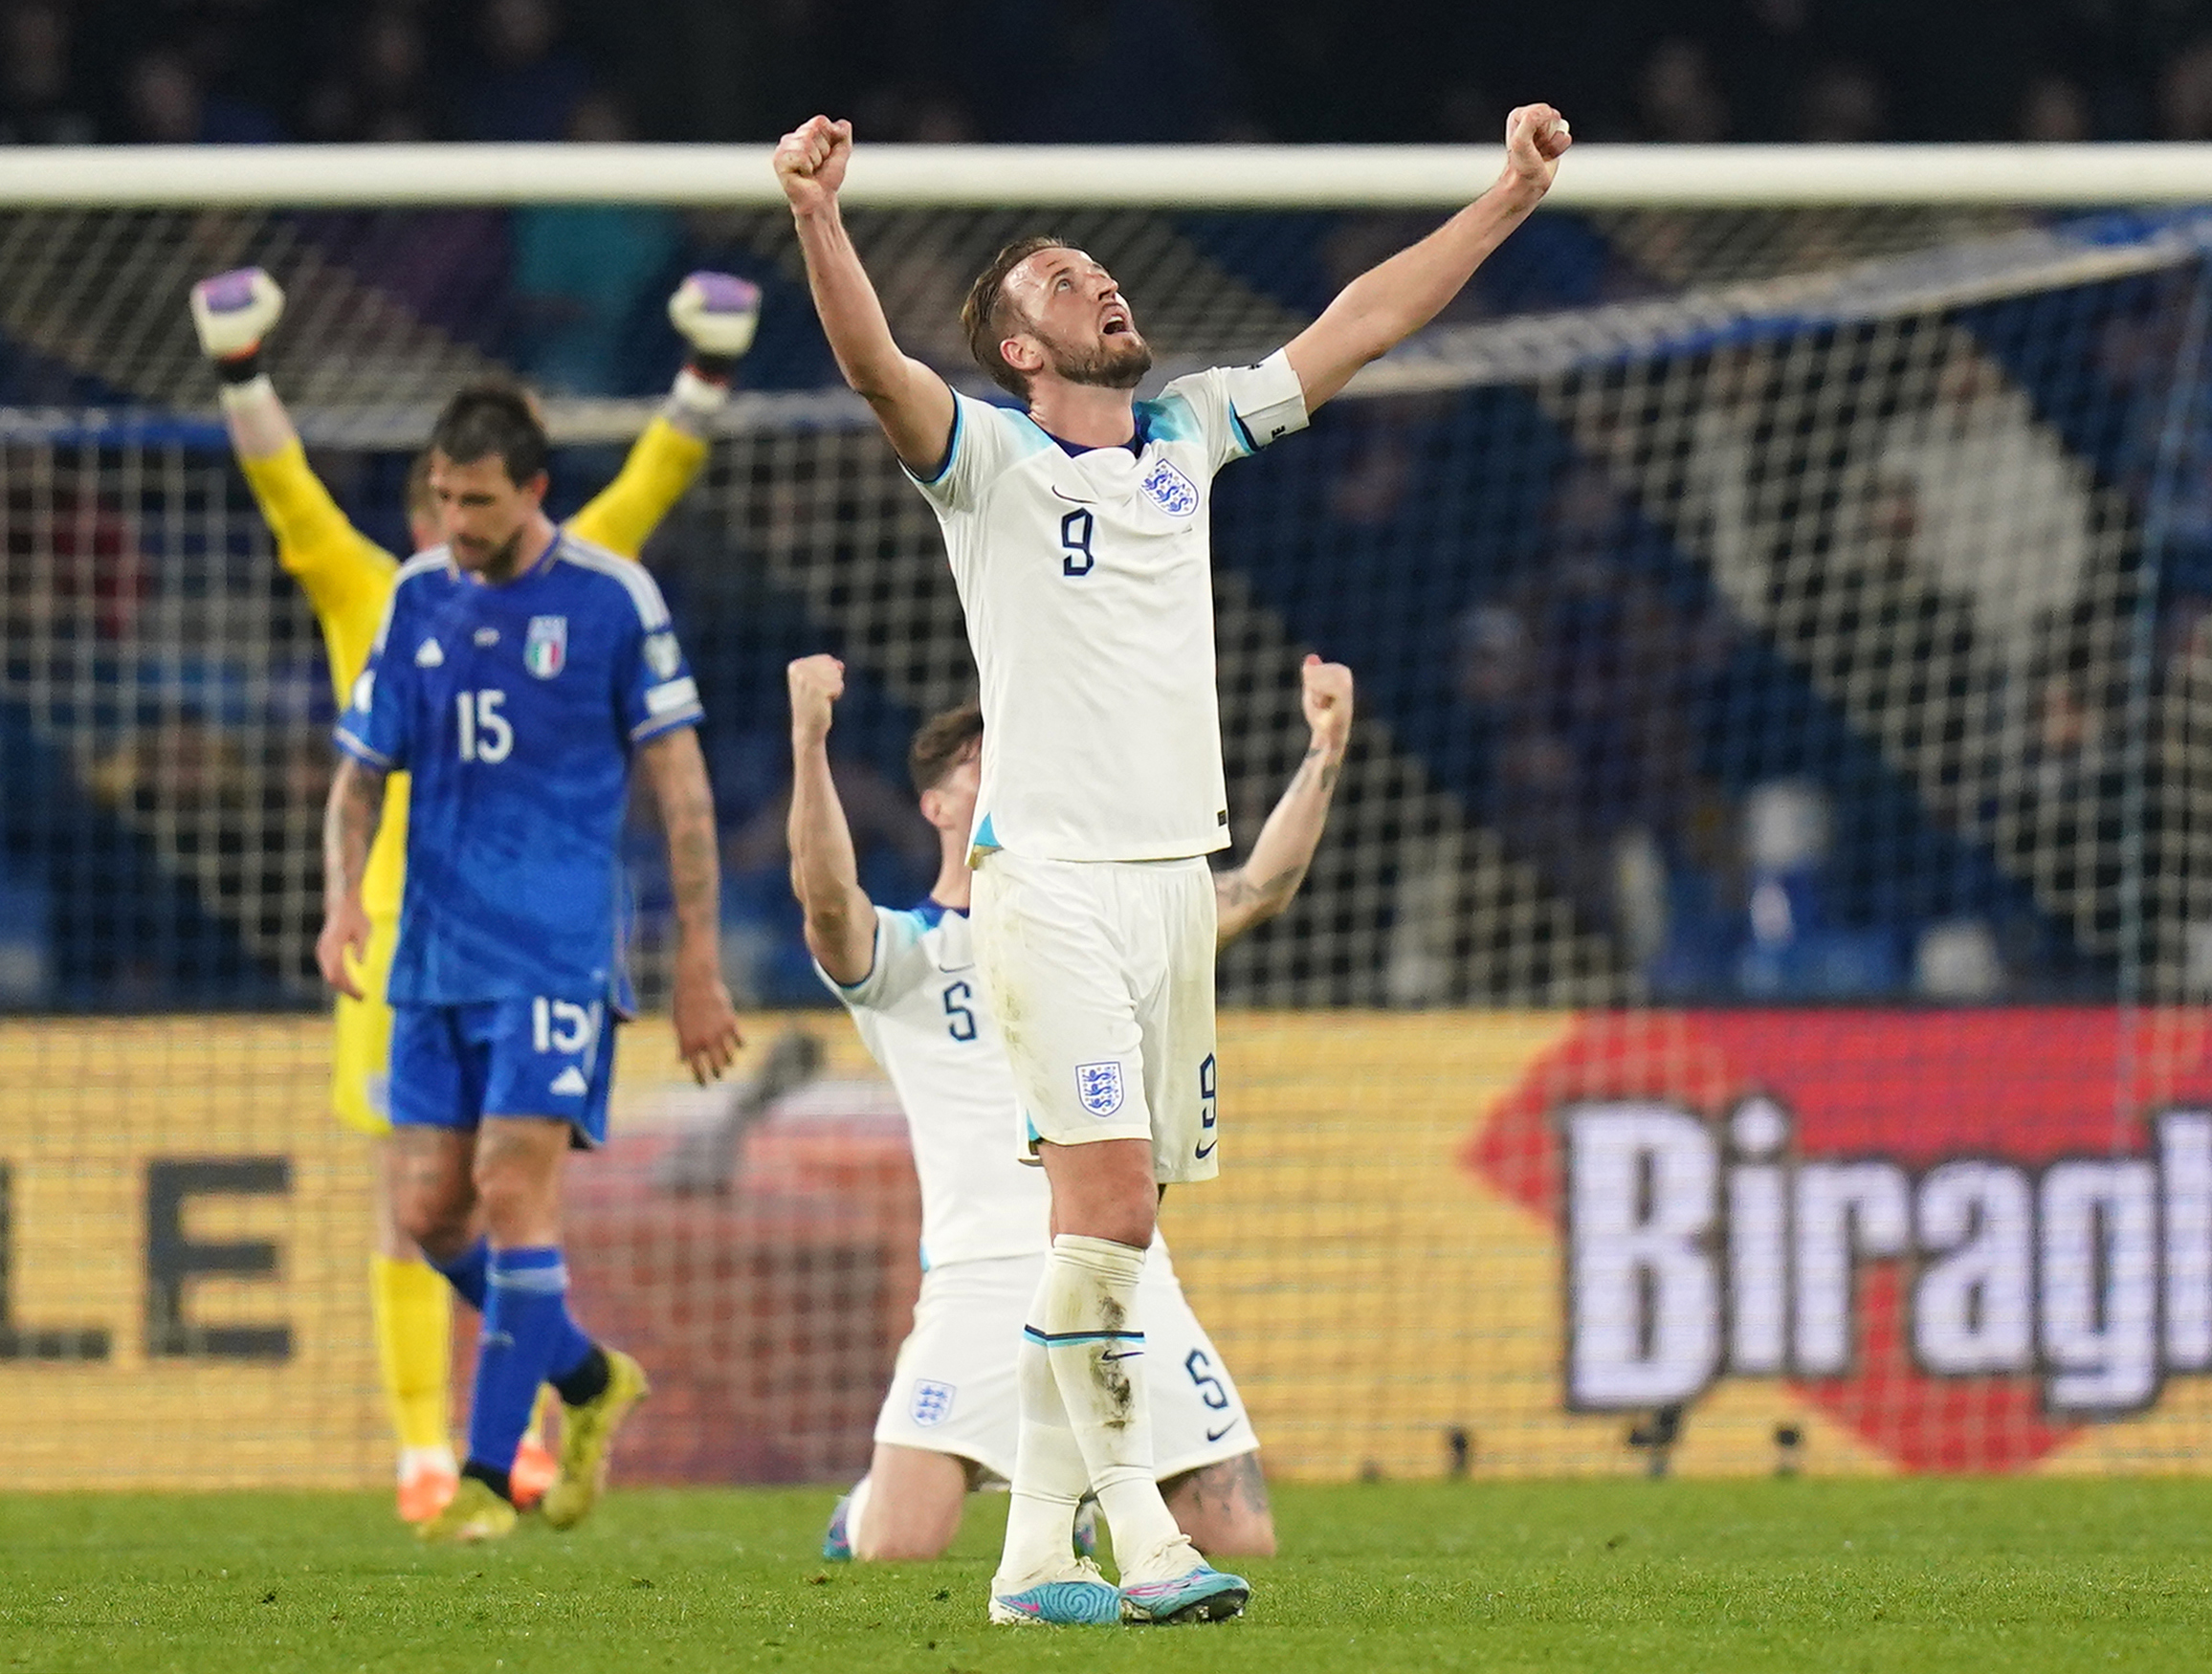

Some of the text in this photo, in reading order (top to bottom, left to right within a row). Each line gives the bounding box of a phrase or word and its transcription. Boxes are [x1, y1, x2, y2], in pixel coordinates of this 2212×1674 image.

[1061, 508, 1095, 577] 9
[455, 688, 514, 764] 15
[532, 995, 592, 1054] 15
[942, 980, 977, 1042] 5
[1199, 1051, 1217, 1130] 9
[1184, 1348, 1228, 1409] 5
